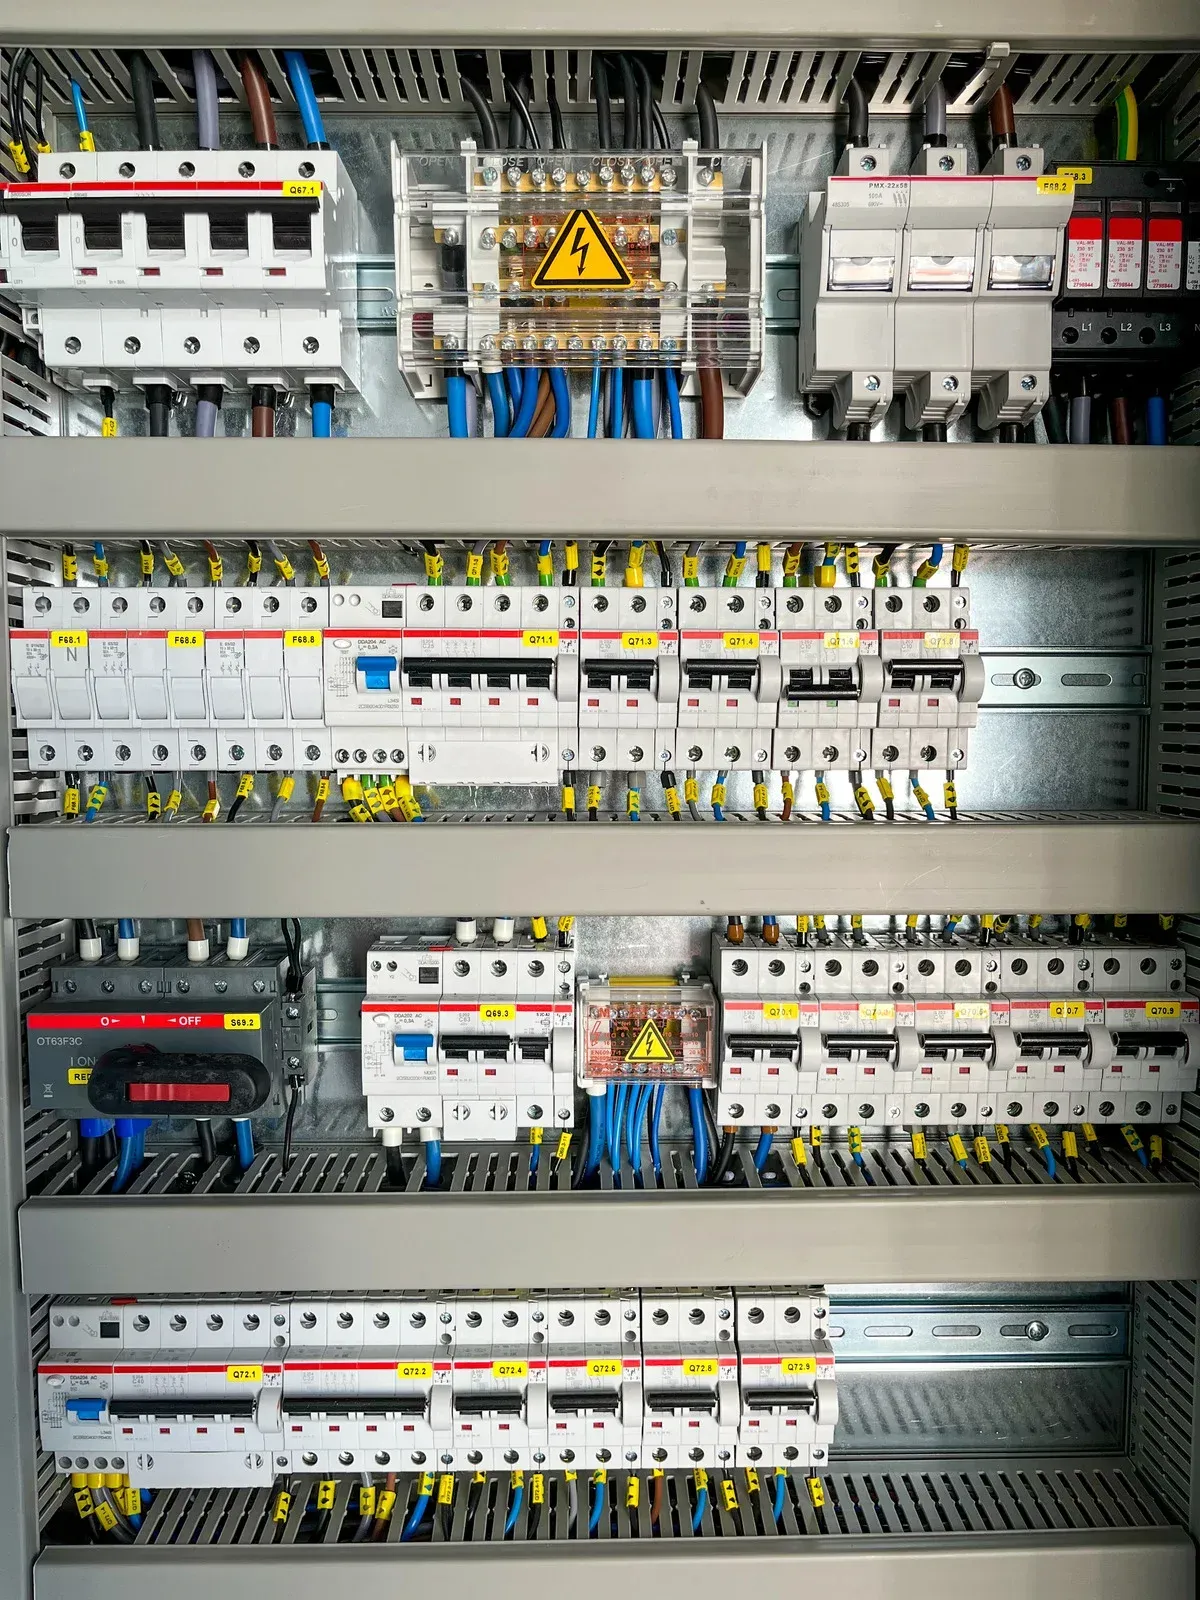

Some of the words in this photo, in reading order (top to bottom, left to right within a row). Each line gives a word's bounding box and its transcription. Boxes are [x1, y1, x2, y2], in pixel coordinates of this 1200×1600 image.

[419, 156, 454, 167] OPEN
[1064, 172, 1086, 181] 8.3
[290, 186, 315, 195] Q67.1
[1043, 182, 1067, 191] F68.2
[1082, 323, 1092, 331] L1
[1121, 323, 1132, 331] L2
[1160, 323, 1171, 331] L3
[58, 636, 81, 644] F68.1
[174, 636, 197, 644] F68.5
[292, 635, 315, 643] F68.8
[529, 636, 553, 644] Q71.1
[628, 637, 652, 646] Q71.3
[729, 637, 754, 646] Q71.4
[66, 647, 78, 662] N
[485, 1010, 509, 1018] Q69.3
[769, 1008, 792, 1016] Q70.1
[1151, 1007, 1175, 1015] Q70.9
[179, 1016, 202, 1026] OFF
[230, 1018, 254, 1027] S69.2
[36, 1037, 83, 1046] OT63F3C
[77, 1056, 96, 1066] ON
[499, 1366, 523, 1375] Q72.4
[593, 1365, 616, 1373] Q72.6
[689, 1364, 713, 1373] Q72.8
[787, 1363, 811, 1371] Q72.9
[233, 1370, 257, 1379] Q72.1
[403, 1368, 427, 1377] Q72.2
